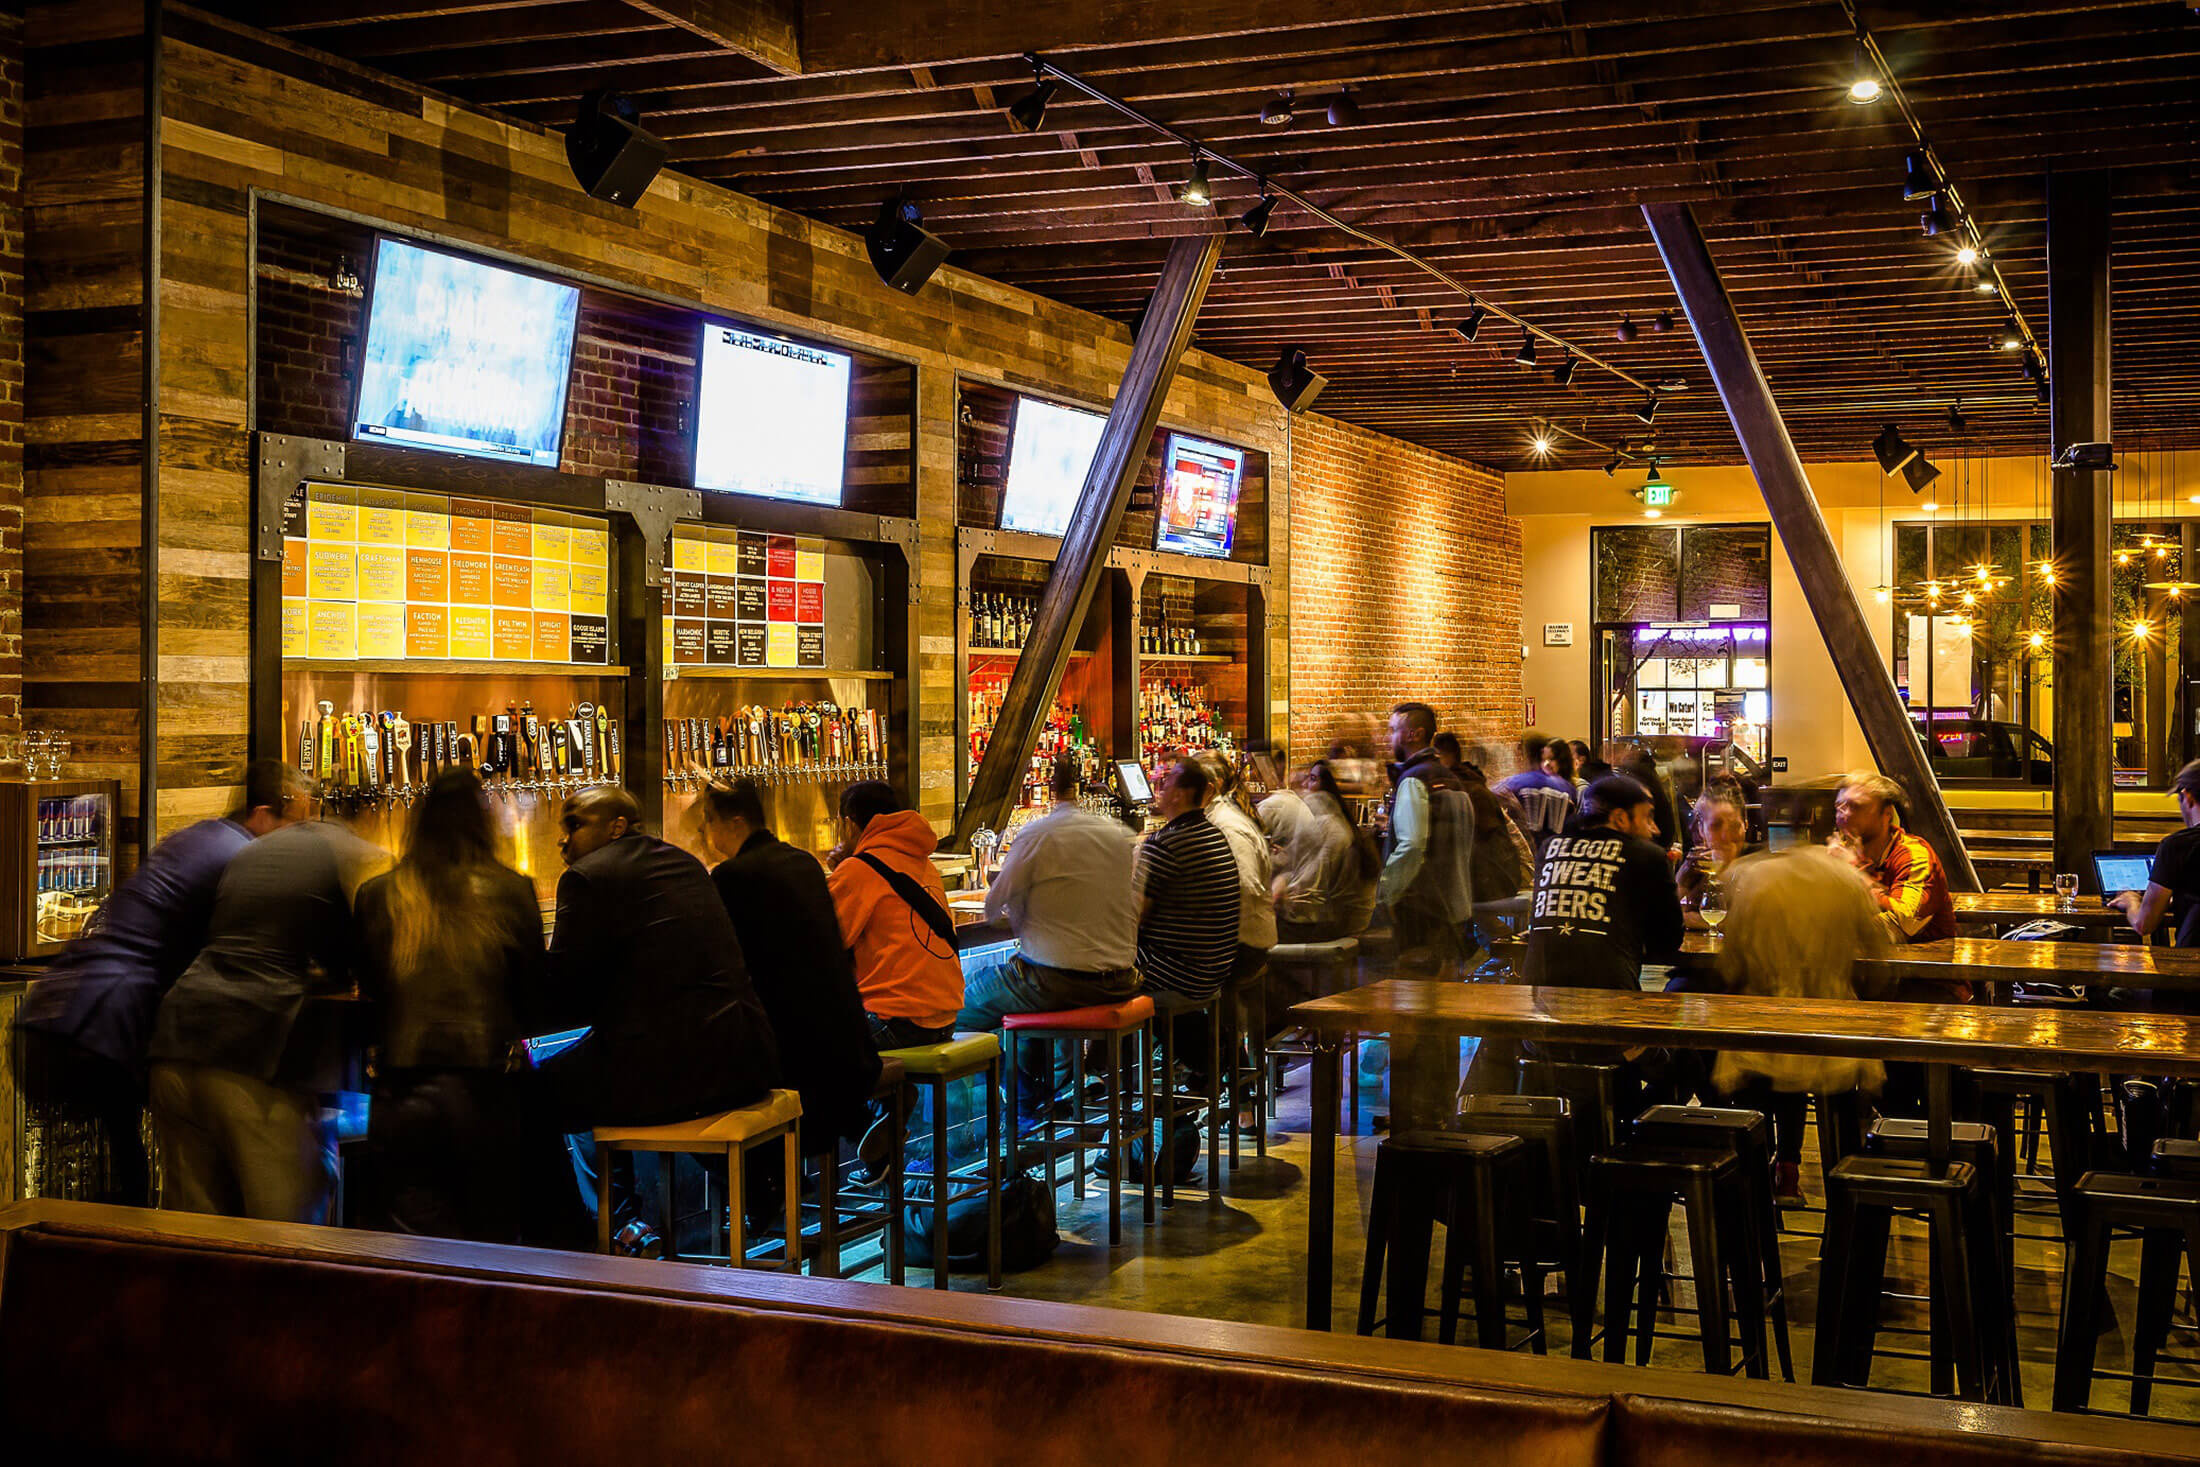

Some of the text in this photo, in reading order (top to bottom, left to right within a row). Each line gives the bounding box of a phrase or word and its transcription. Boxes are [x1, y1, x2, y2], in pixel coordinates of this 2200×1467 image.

[1545, 837, 1627, 864] BLOOD.
[1539, 860, 1620, 893] SWEAT.
[1534, 888, 1612, 924] BEERS.
